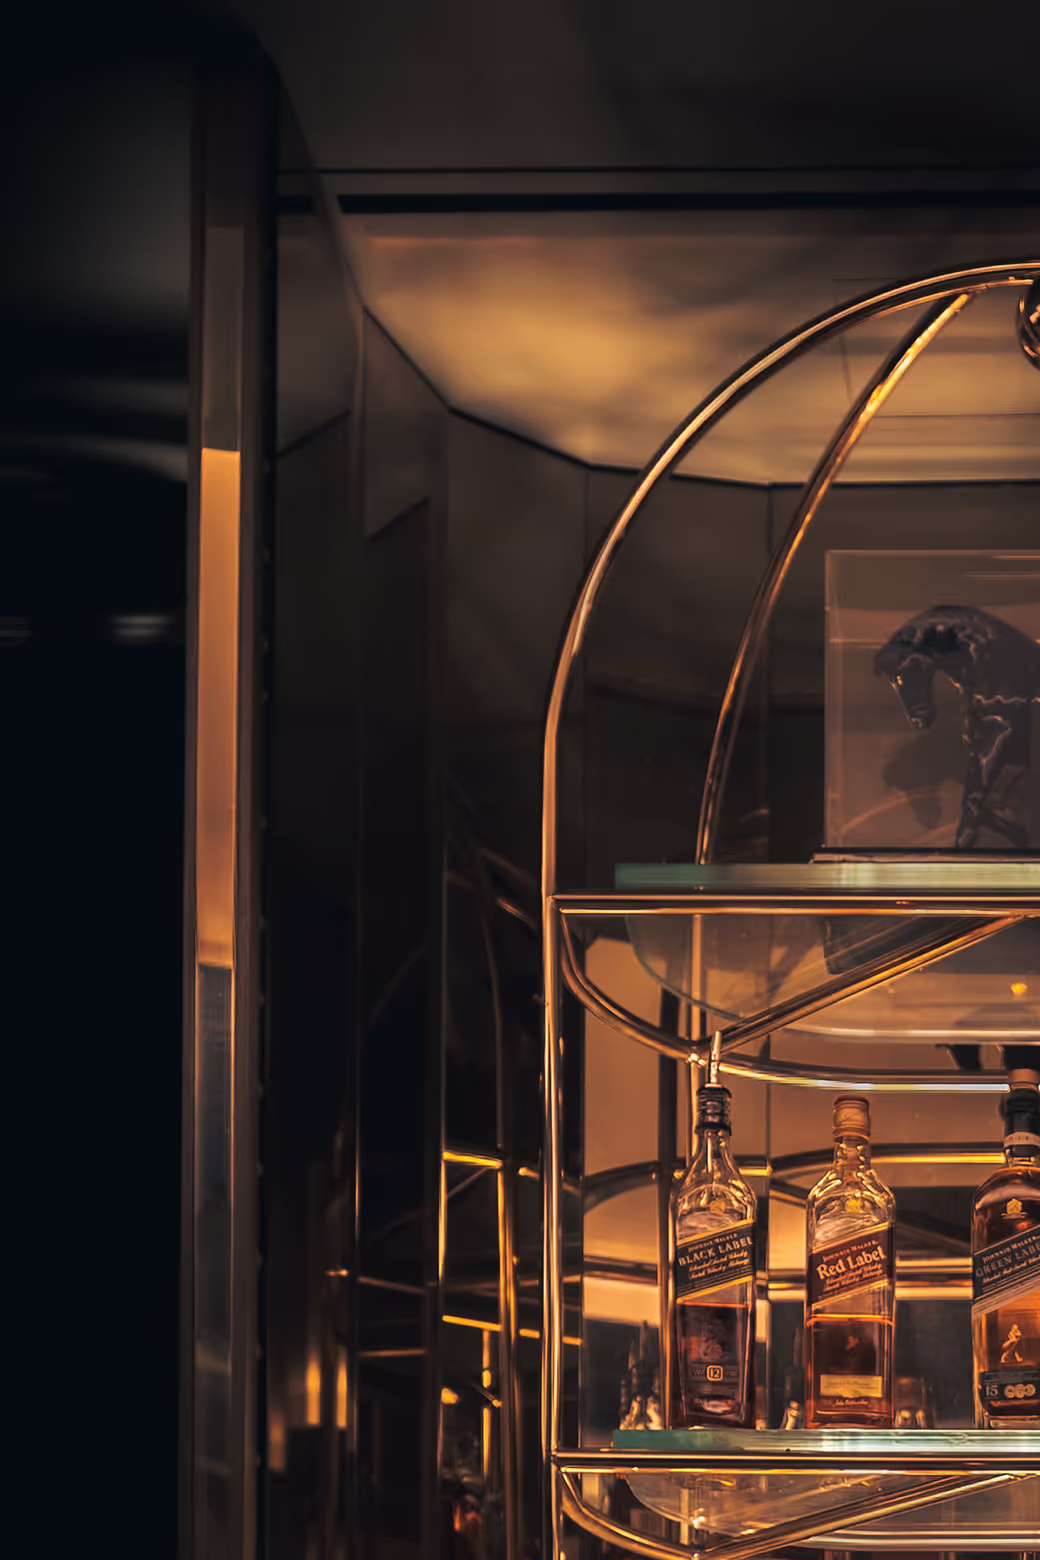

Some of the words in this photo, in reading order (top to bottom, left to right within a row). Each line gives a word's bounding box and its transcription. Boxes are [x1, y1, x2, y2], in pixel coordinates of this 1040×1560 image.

[678, 1247, 715, 1266] BLACK
[718, 1236, 753, 1254] LABEL
[816, 1258, 847, 1280] Red
[847, 1245, 887, 1269] Label
[976, 1256, 1013, 1277] GREEN
[985, 1383, 999, 1397] 15
